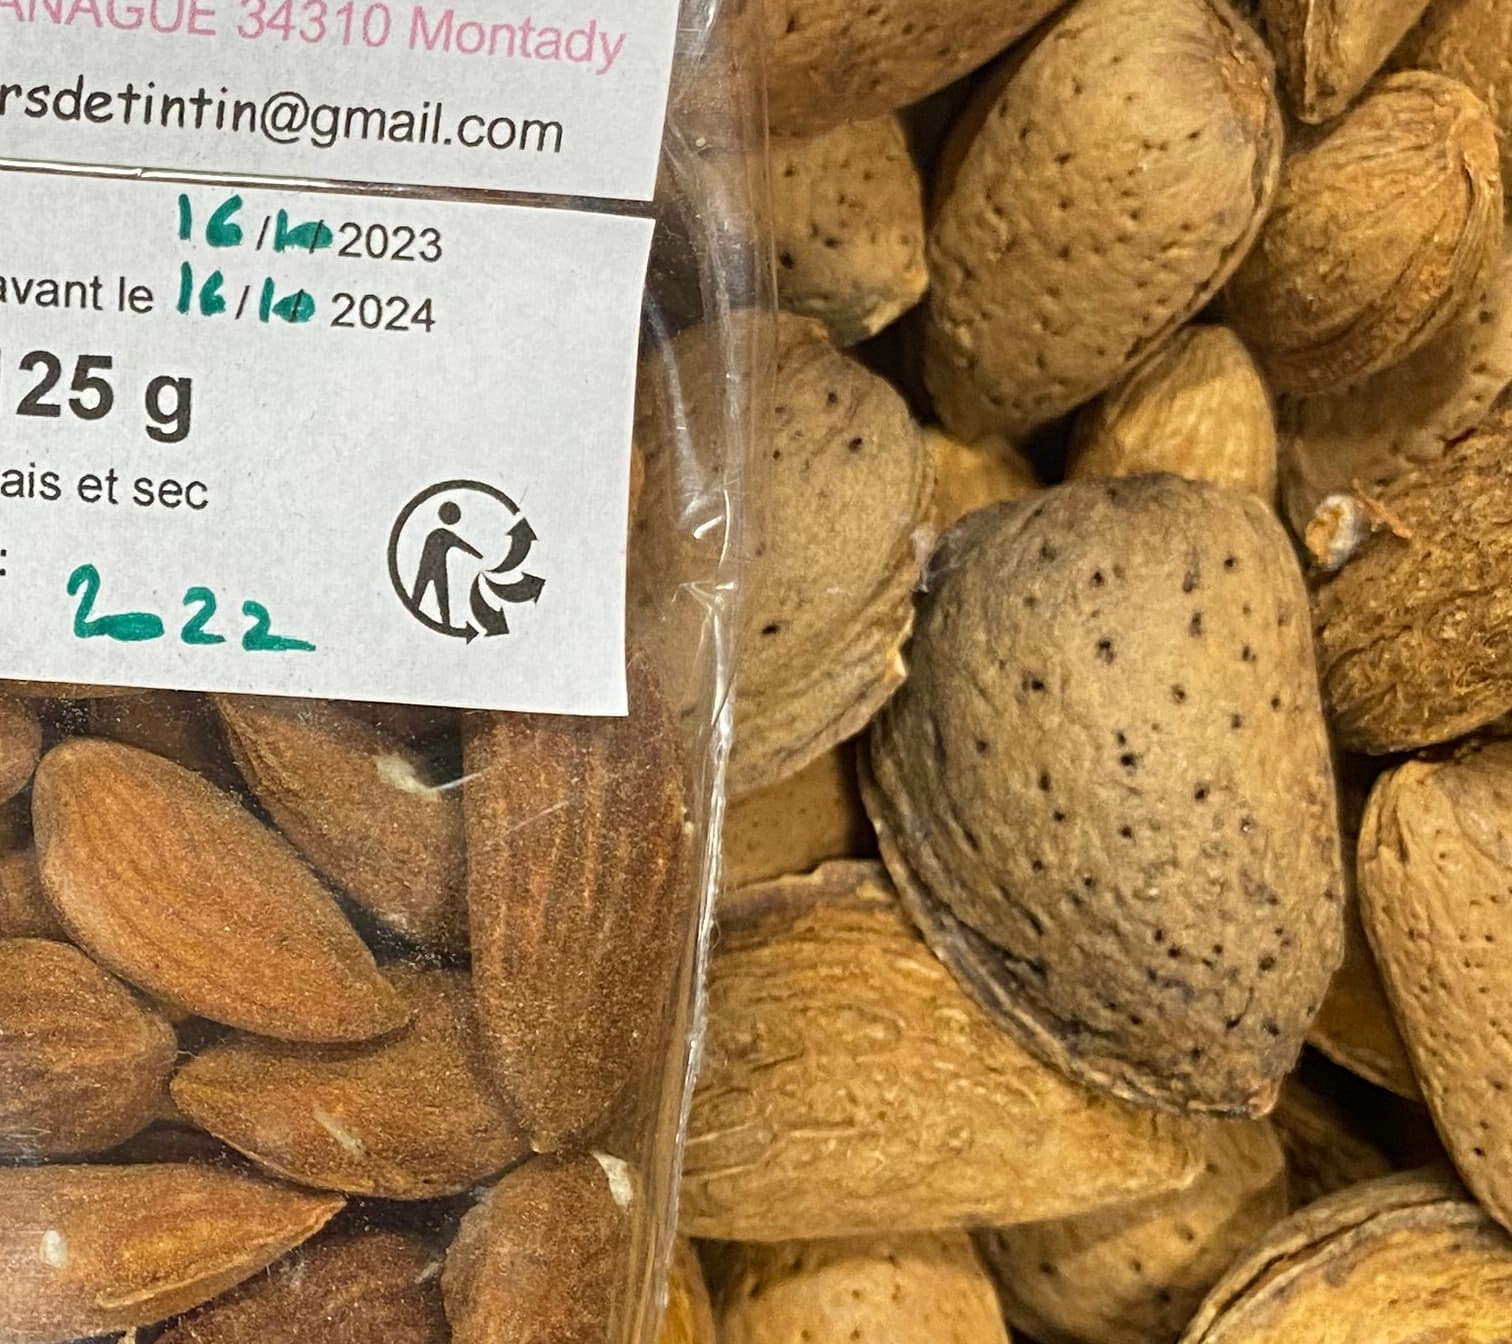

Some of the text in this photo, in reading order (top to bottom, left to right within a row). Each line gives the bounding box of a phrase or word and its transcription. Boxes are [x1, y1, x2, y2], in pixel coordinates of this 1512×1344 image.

[410, 7, 624, 74] Montady
[118, 276, 154, 314] le
[145, 375, 192, 443] g
[77, 468, 119, 505] et
[133, 477, 208, 510] sec
